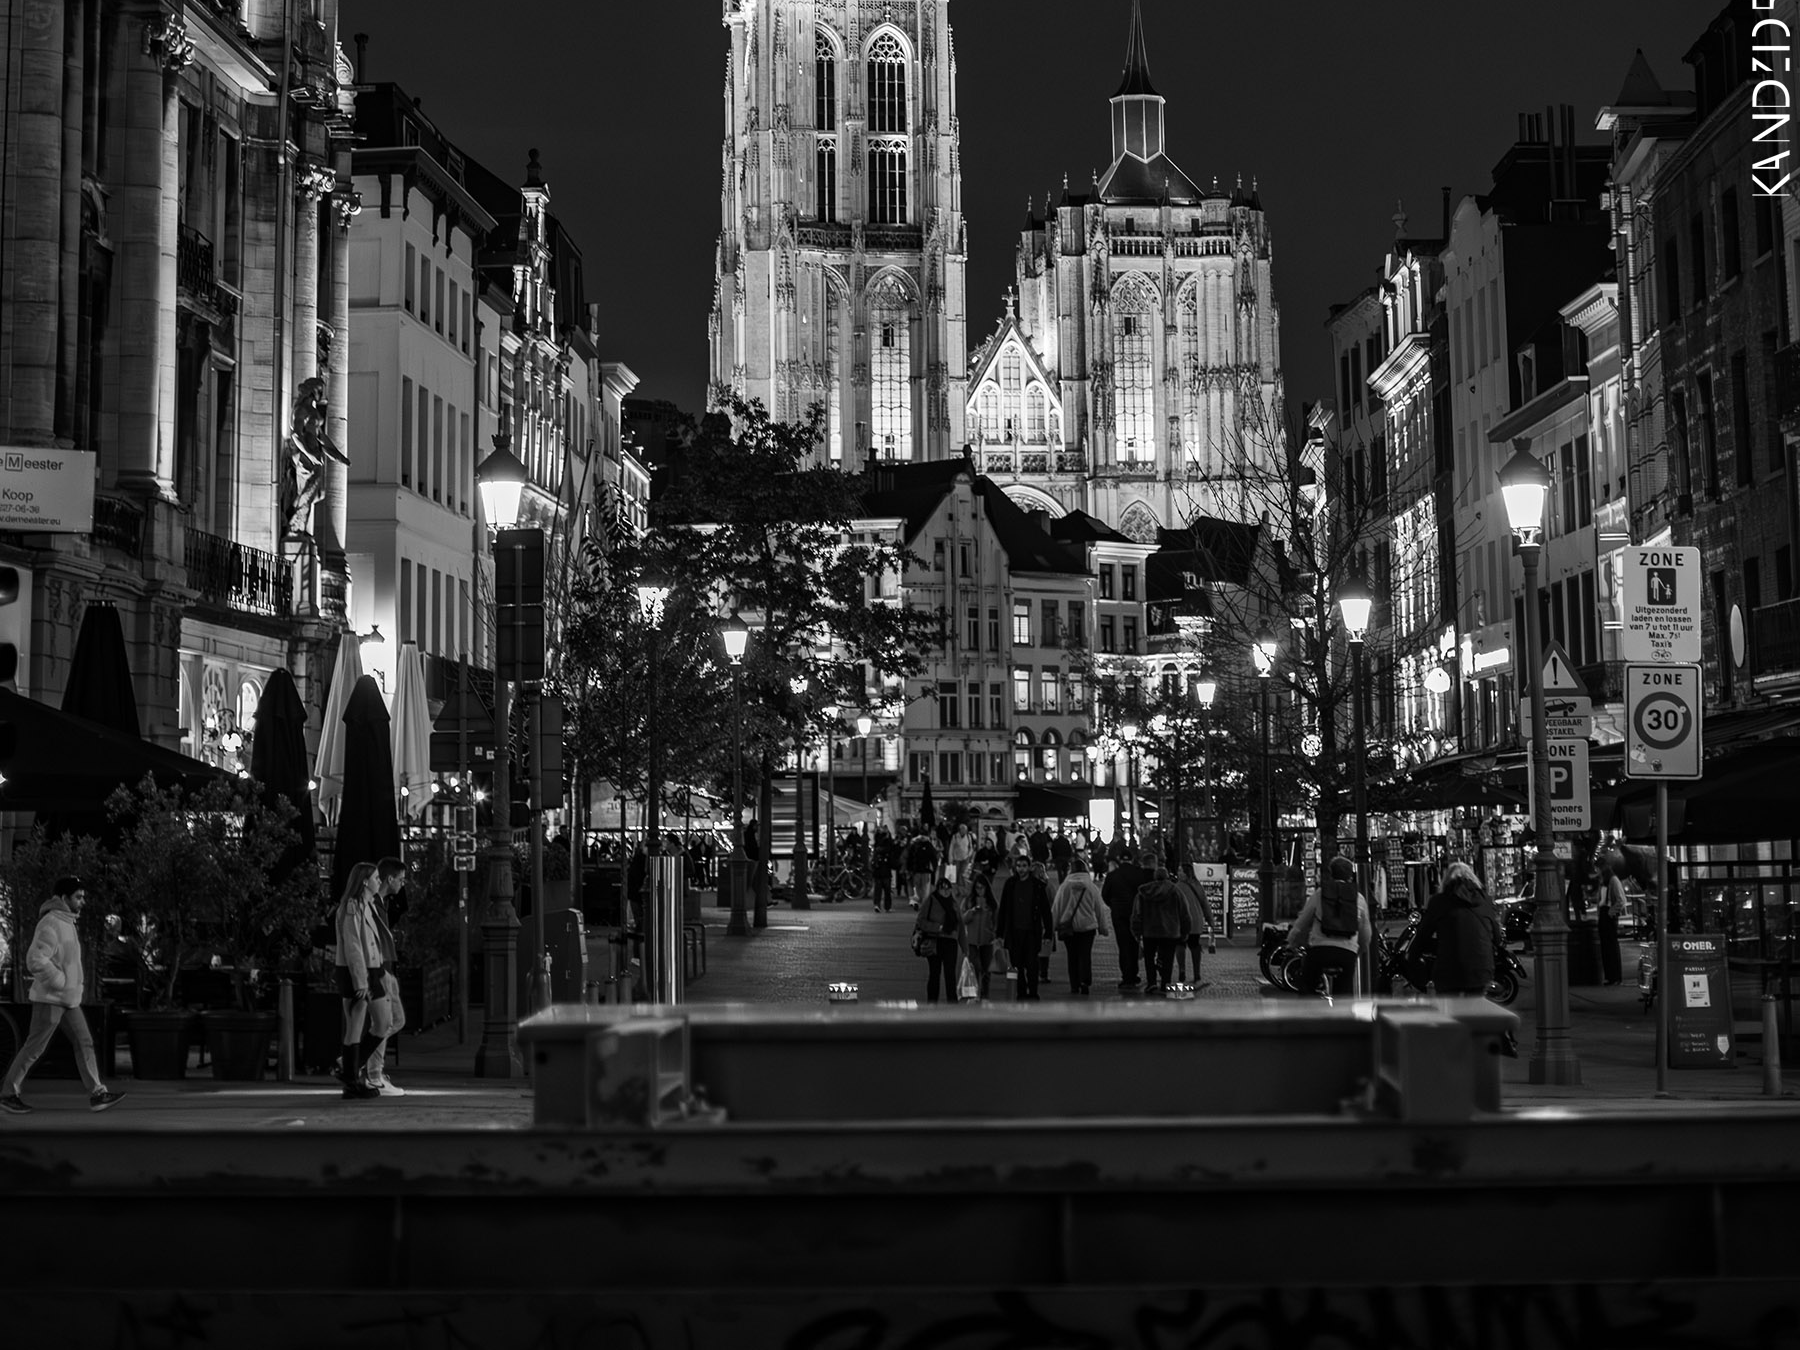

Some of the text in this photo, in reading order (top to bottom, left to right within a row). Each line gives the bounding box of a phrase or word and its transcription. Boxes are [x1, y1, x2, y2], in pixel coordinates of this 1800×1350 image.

[2, 489, 34, 503] Koop
[1639, 552, 1684, 566] ZONE
[1635, 606, 1688, 615] Uitgezonderd
[1631, 614, 1653, 622] laden
[1666, 615, 1692, 623] lossen
[1648, 631, 1667, 639] Max.
[1651, 640, 1672, 648] Taxi's
[1642, 673, 1683, 685] ZONE
[1546, 719, 1583, 727] EEGBAAR
[1647, 709, 1679, 730] 30
[1547, 728, 1576, 736] STAKEL
[1549, 745, 1577, 757] ONE
[1550, 767, 1568, 793] P
[1551, 805, 1583, 813] woners
[1553, 816, 1582, 827] haling
